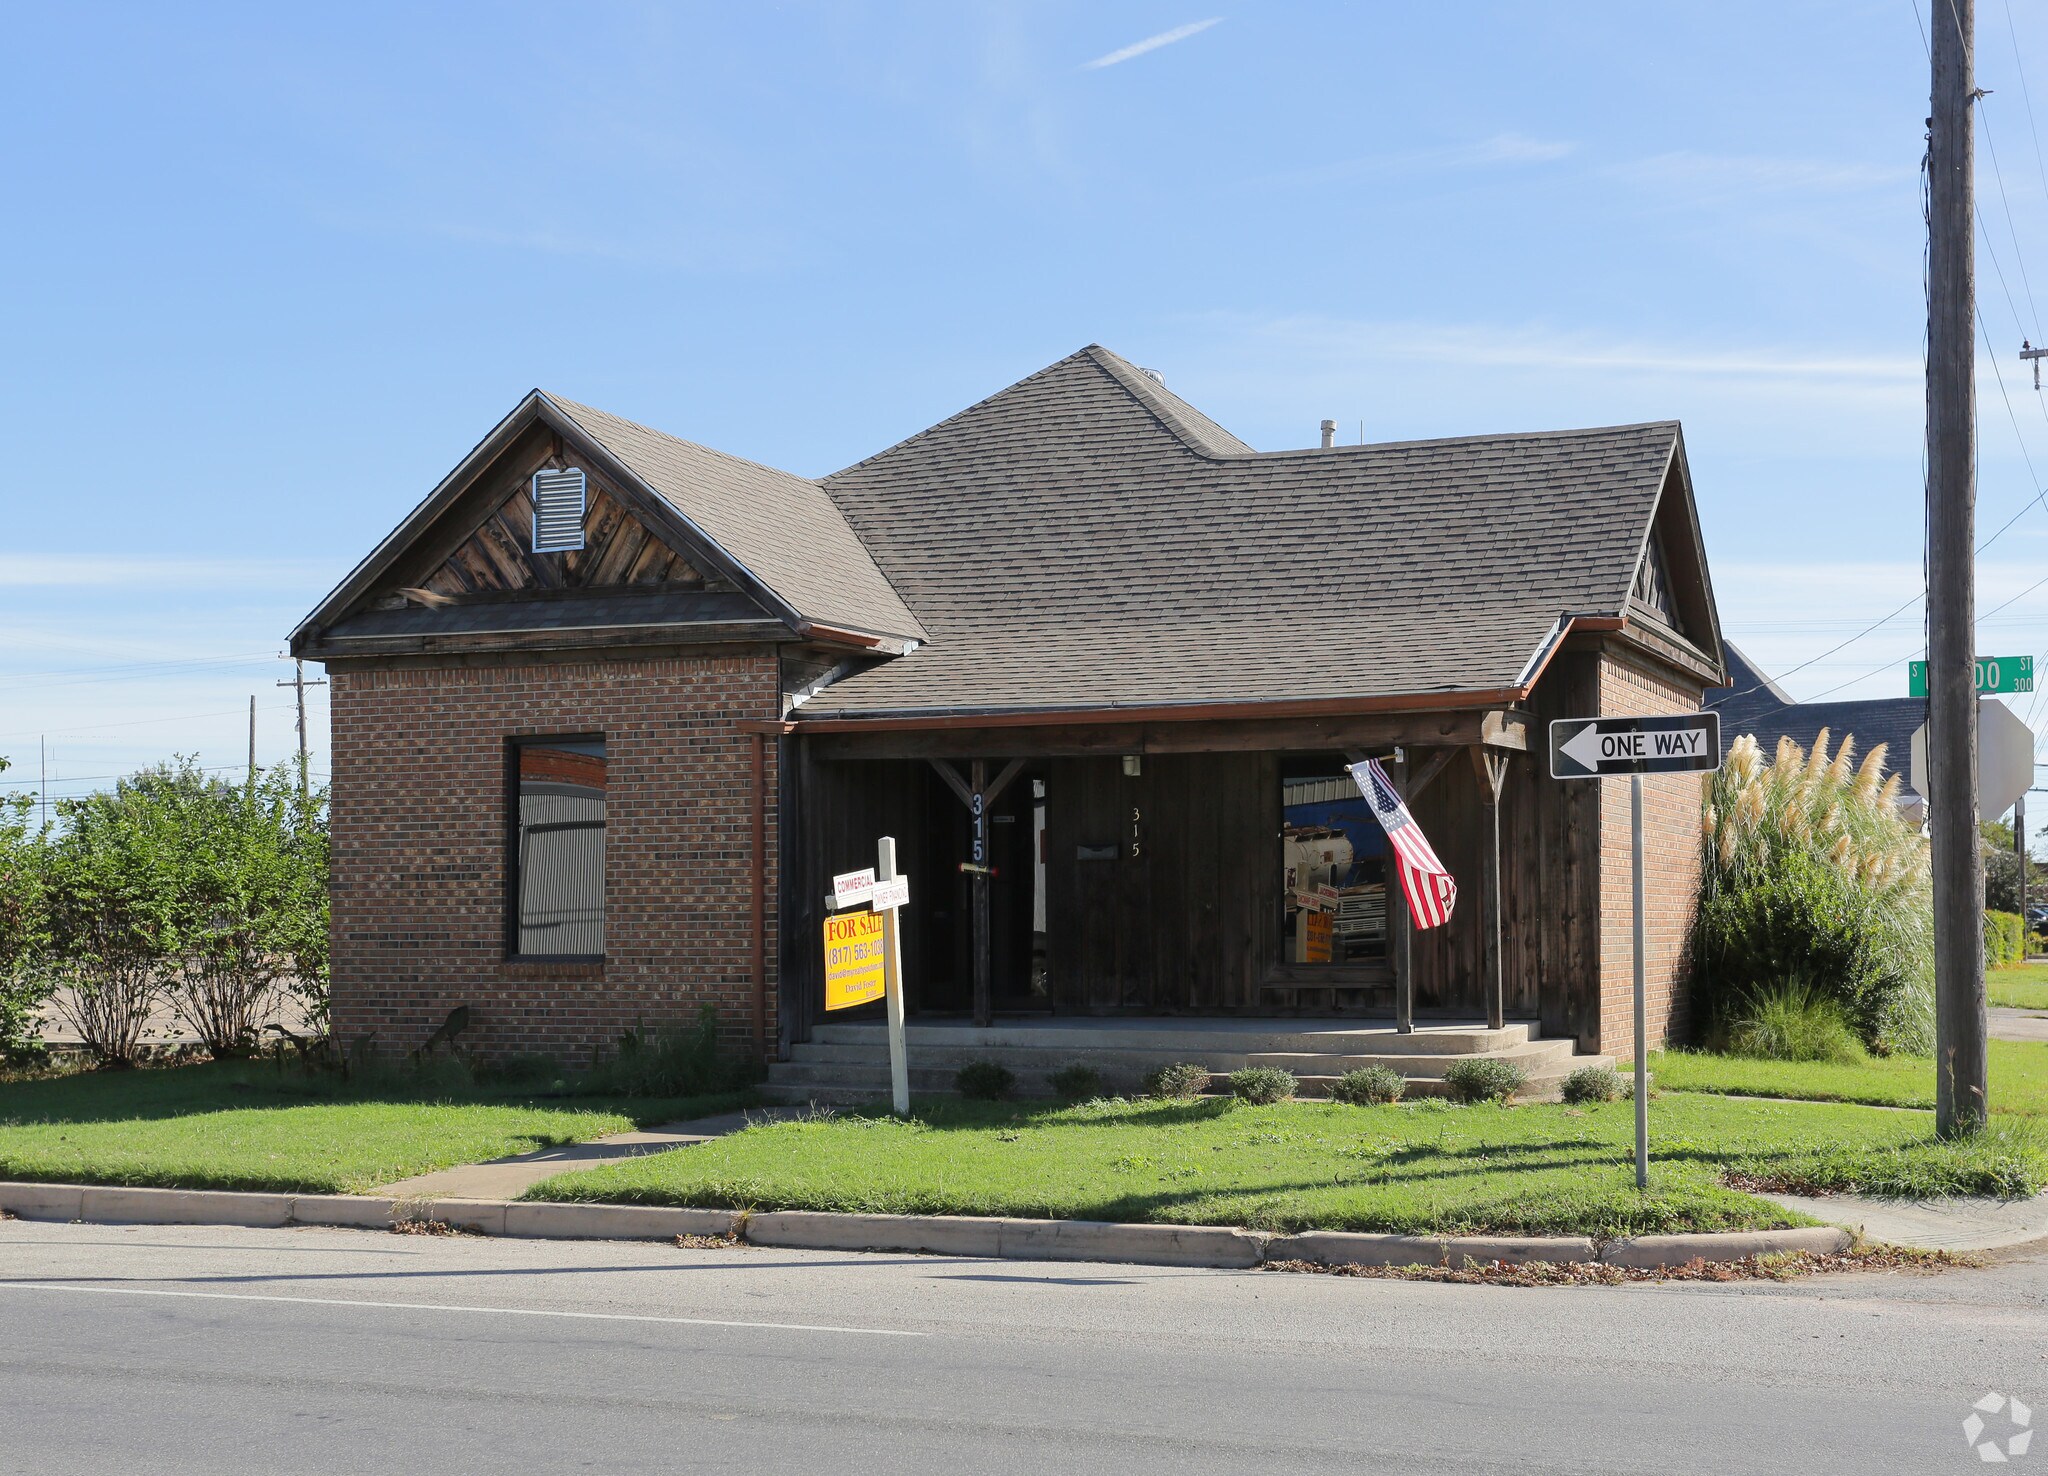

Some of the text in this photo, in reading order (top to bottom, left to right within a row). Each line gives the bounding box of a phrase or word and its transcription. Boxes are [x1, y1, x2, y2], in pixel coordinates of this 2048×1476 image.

[1912, 664, 1918, 677] S
[2020, 657, 2032, 671] ST
[2013, 677, 2032, 692] 300
[1601, 732, 1701, 757] ONE WAY
[973, 793, 982, 861] 315
[1132, 807, 1140, 857] 315
[837, 874, 873, 894] COMMERCIAL
[828, 914, 882, 942] FOR SALE
[828, 946, 852, 969] (817)
[845, 979, 877, 993] David Foster
